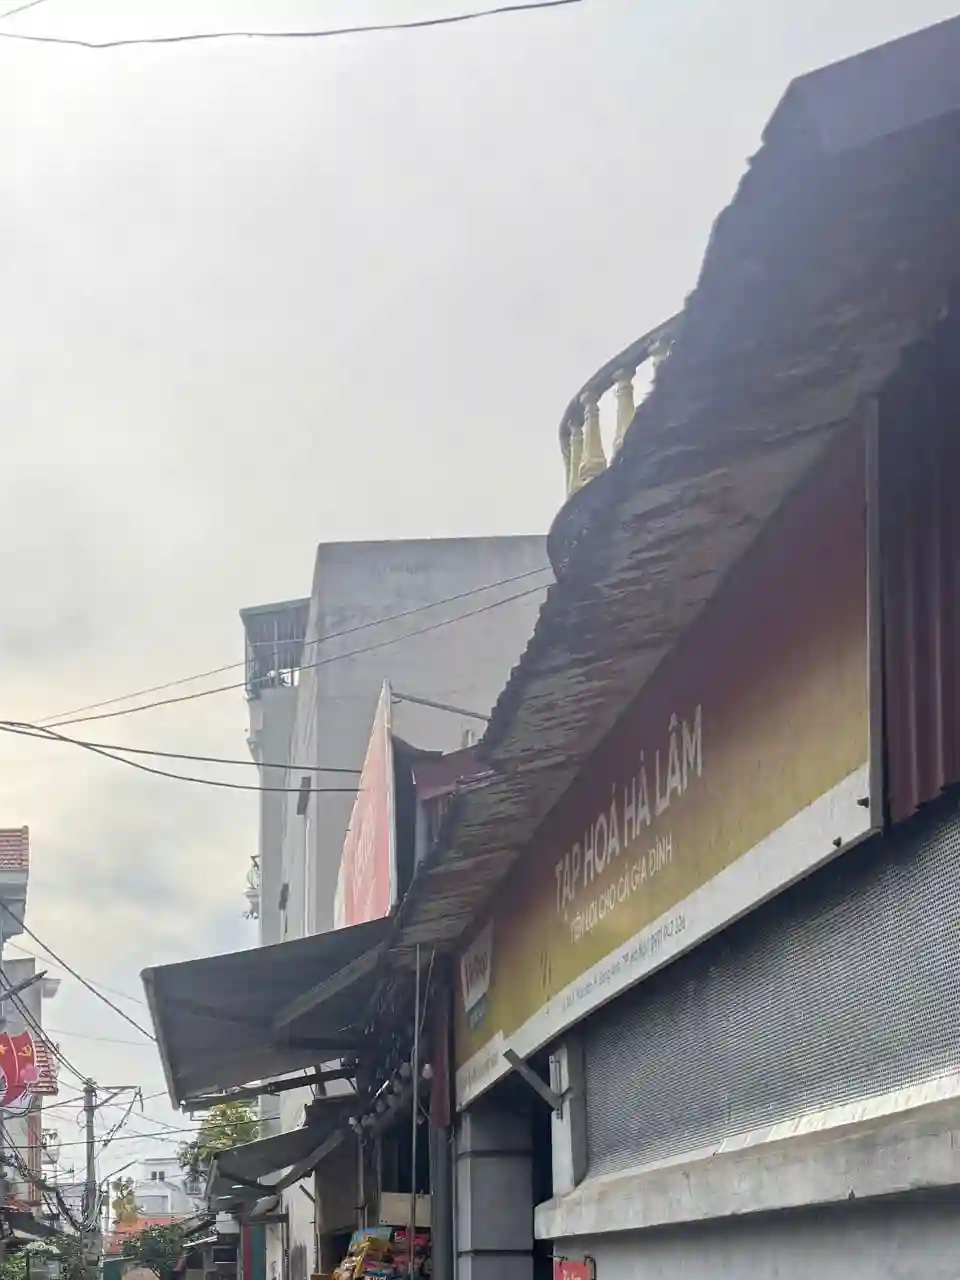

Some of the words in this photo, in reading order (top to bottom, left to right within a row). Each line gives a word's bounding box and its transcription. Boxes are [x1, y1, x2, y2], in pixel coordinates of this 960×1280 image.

[655, 703, 702, 817] LÂM
[599, 884, 616, 919] CHO
[631, 855, 648, 892] GIA
